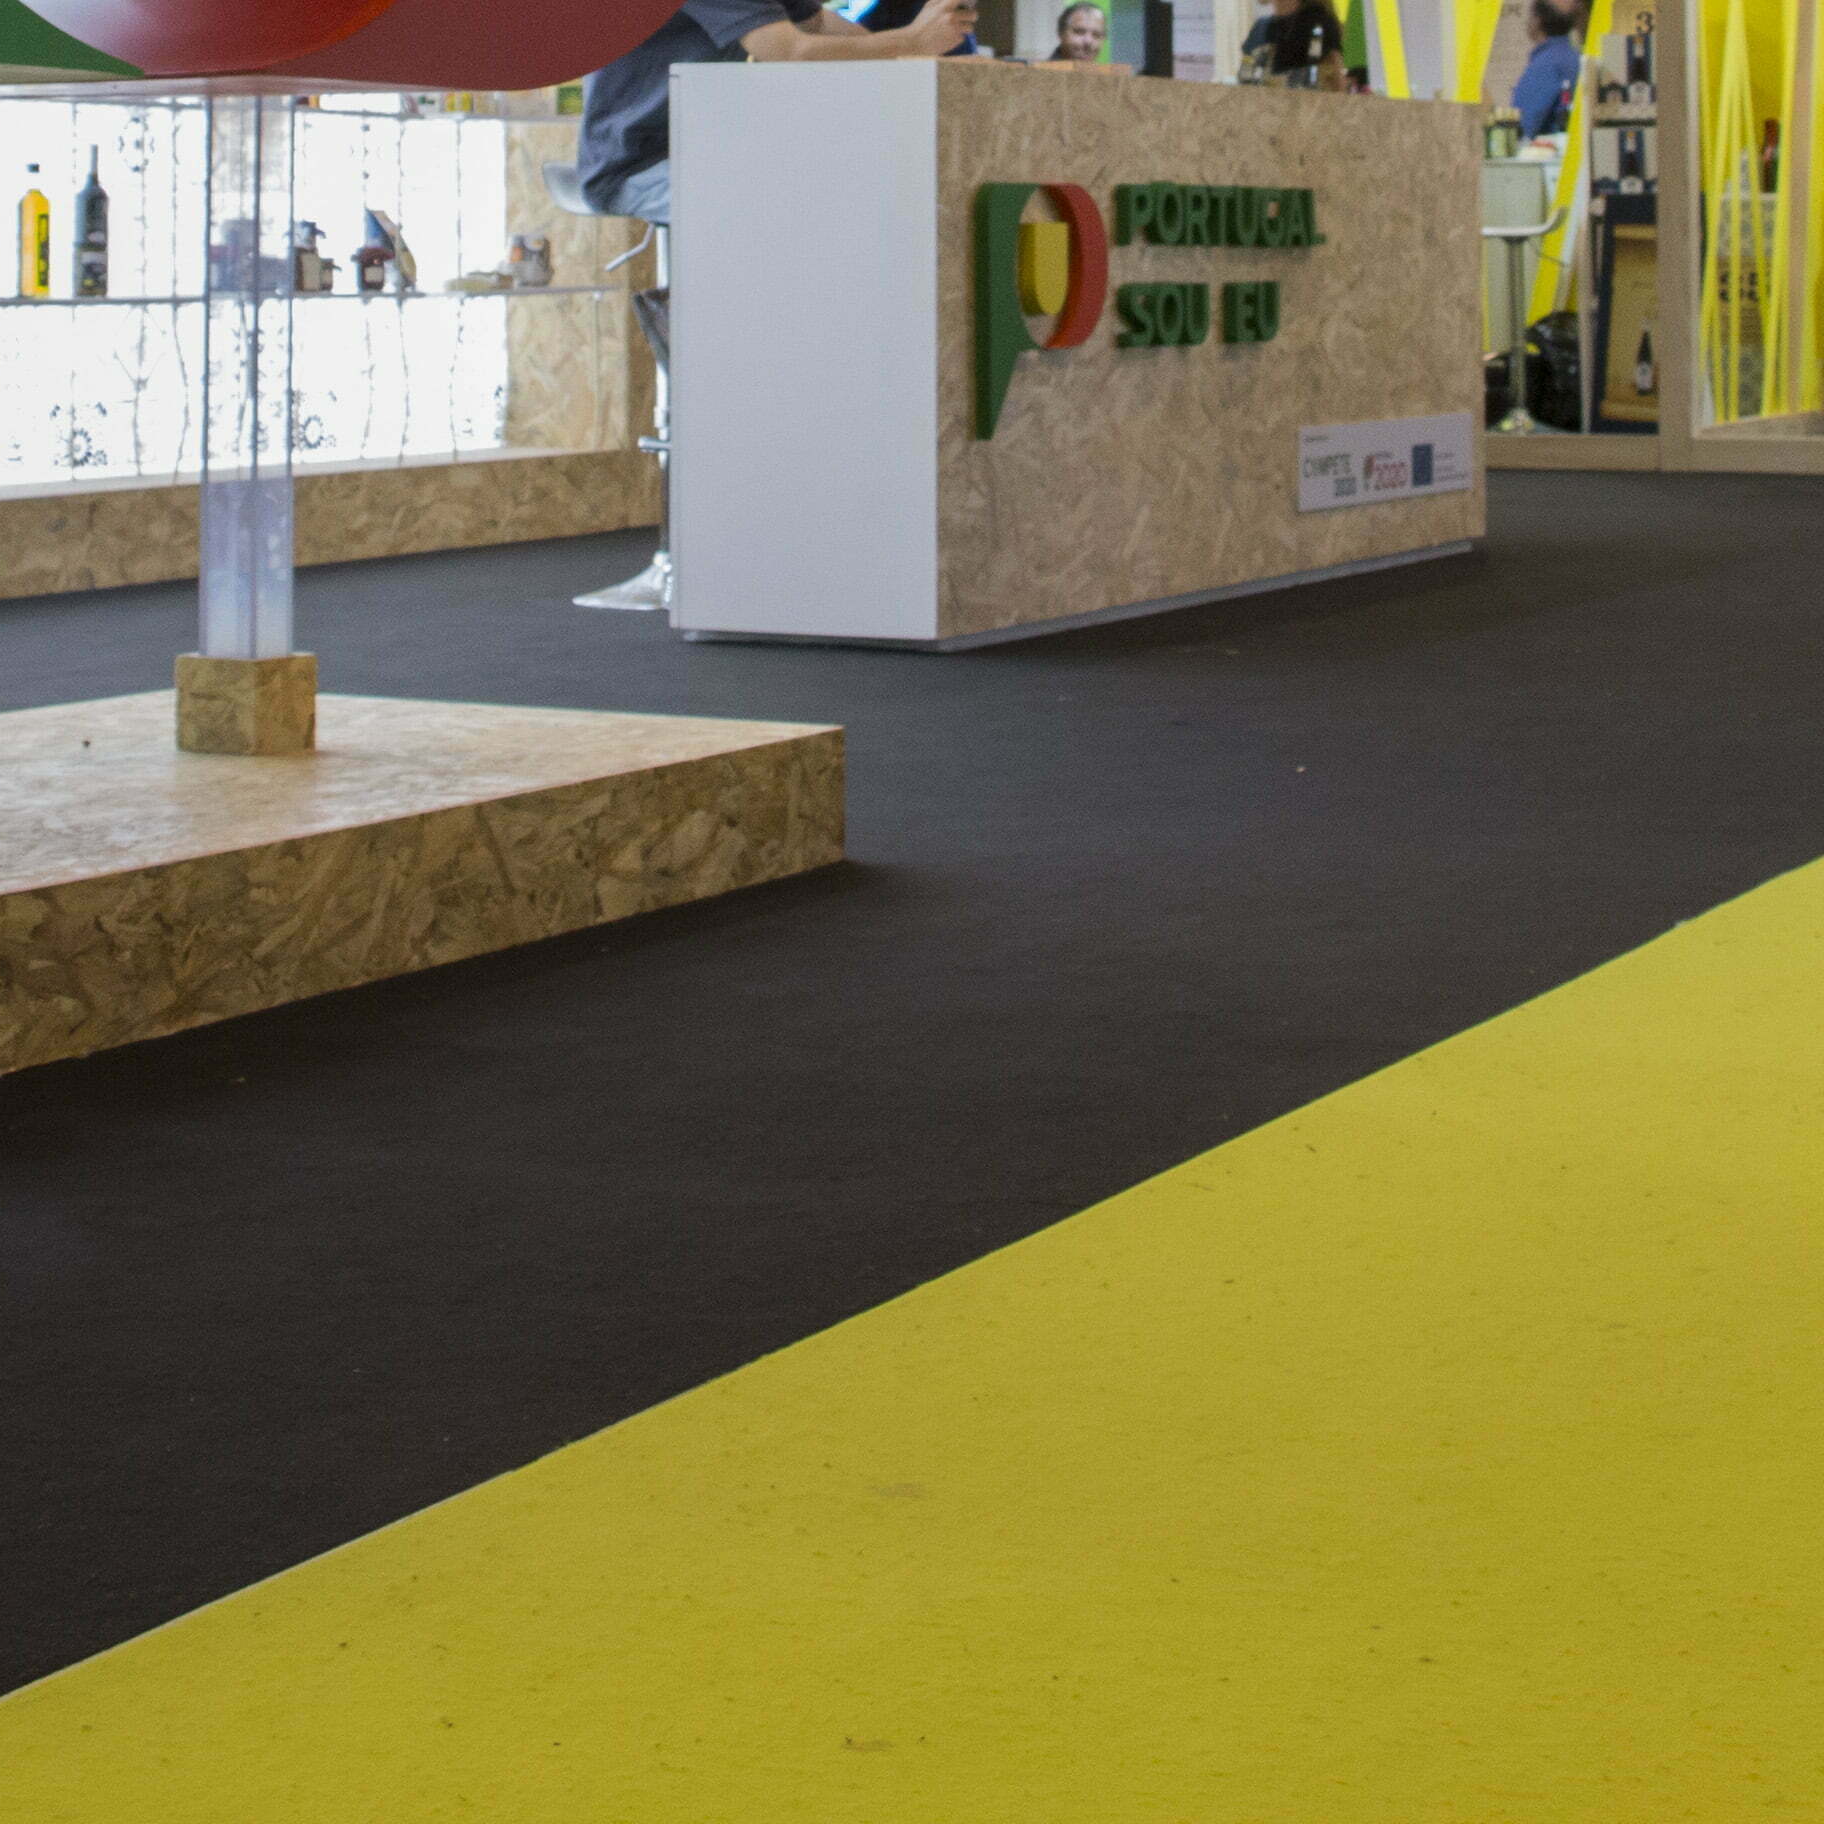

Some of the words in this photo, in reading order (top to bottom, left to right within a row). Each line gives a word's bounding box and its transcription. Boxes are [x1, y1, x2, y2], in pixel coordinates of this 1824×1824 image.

[1112, 181, 1325, 247] PORTUGAL
[1114, 282, 1210, 347] SOU
[1222, 280, 1280, 344] EU
